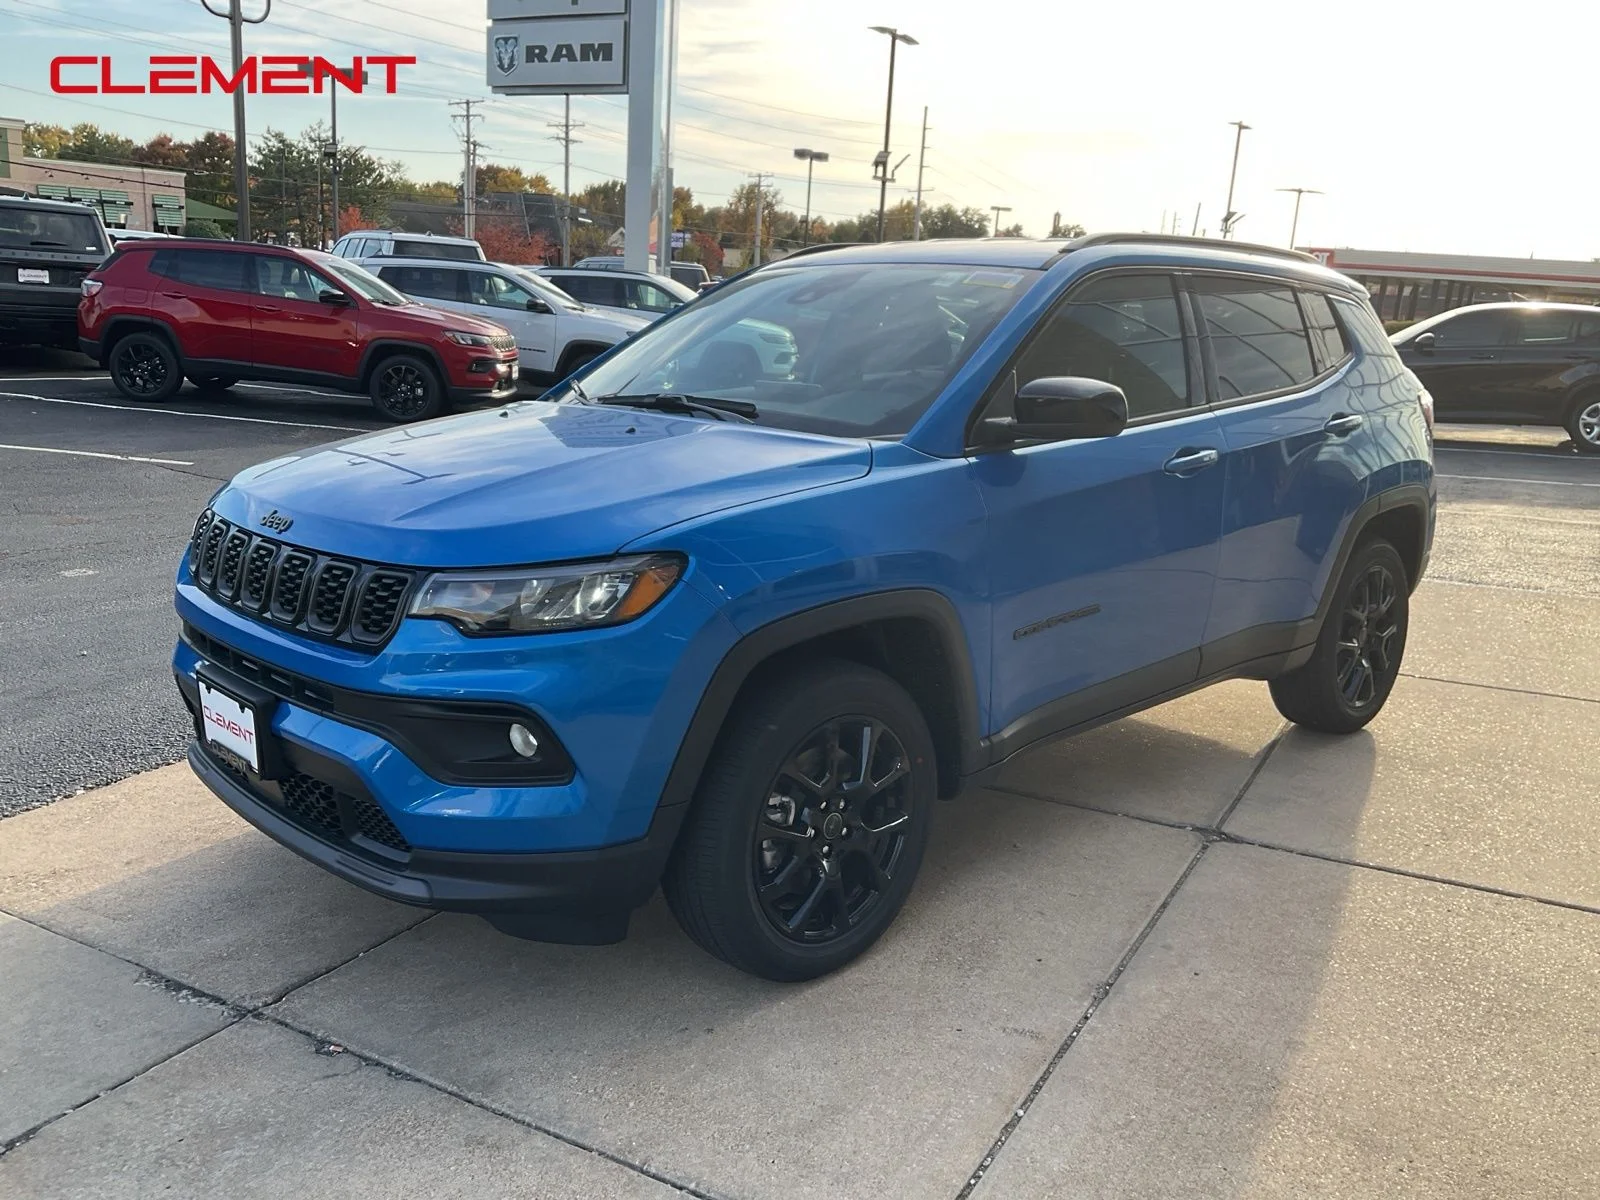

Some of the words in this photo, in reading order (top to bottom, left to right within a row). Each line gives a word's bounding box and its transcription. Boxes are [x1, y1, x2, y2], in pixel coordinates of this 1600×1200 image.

[525, 42, 613, 63] RAM
[260, 509, 294, 534] Jeep
[203, 705, 254, 744] CLEMENT
